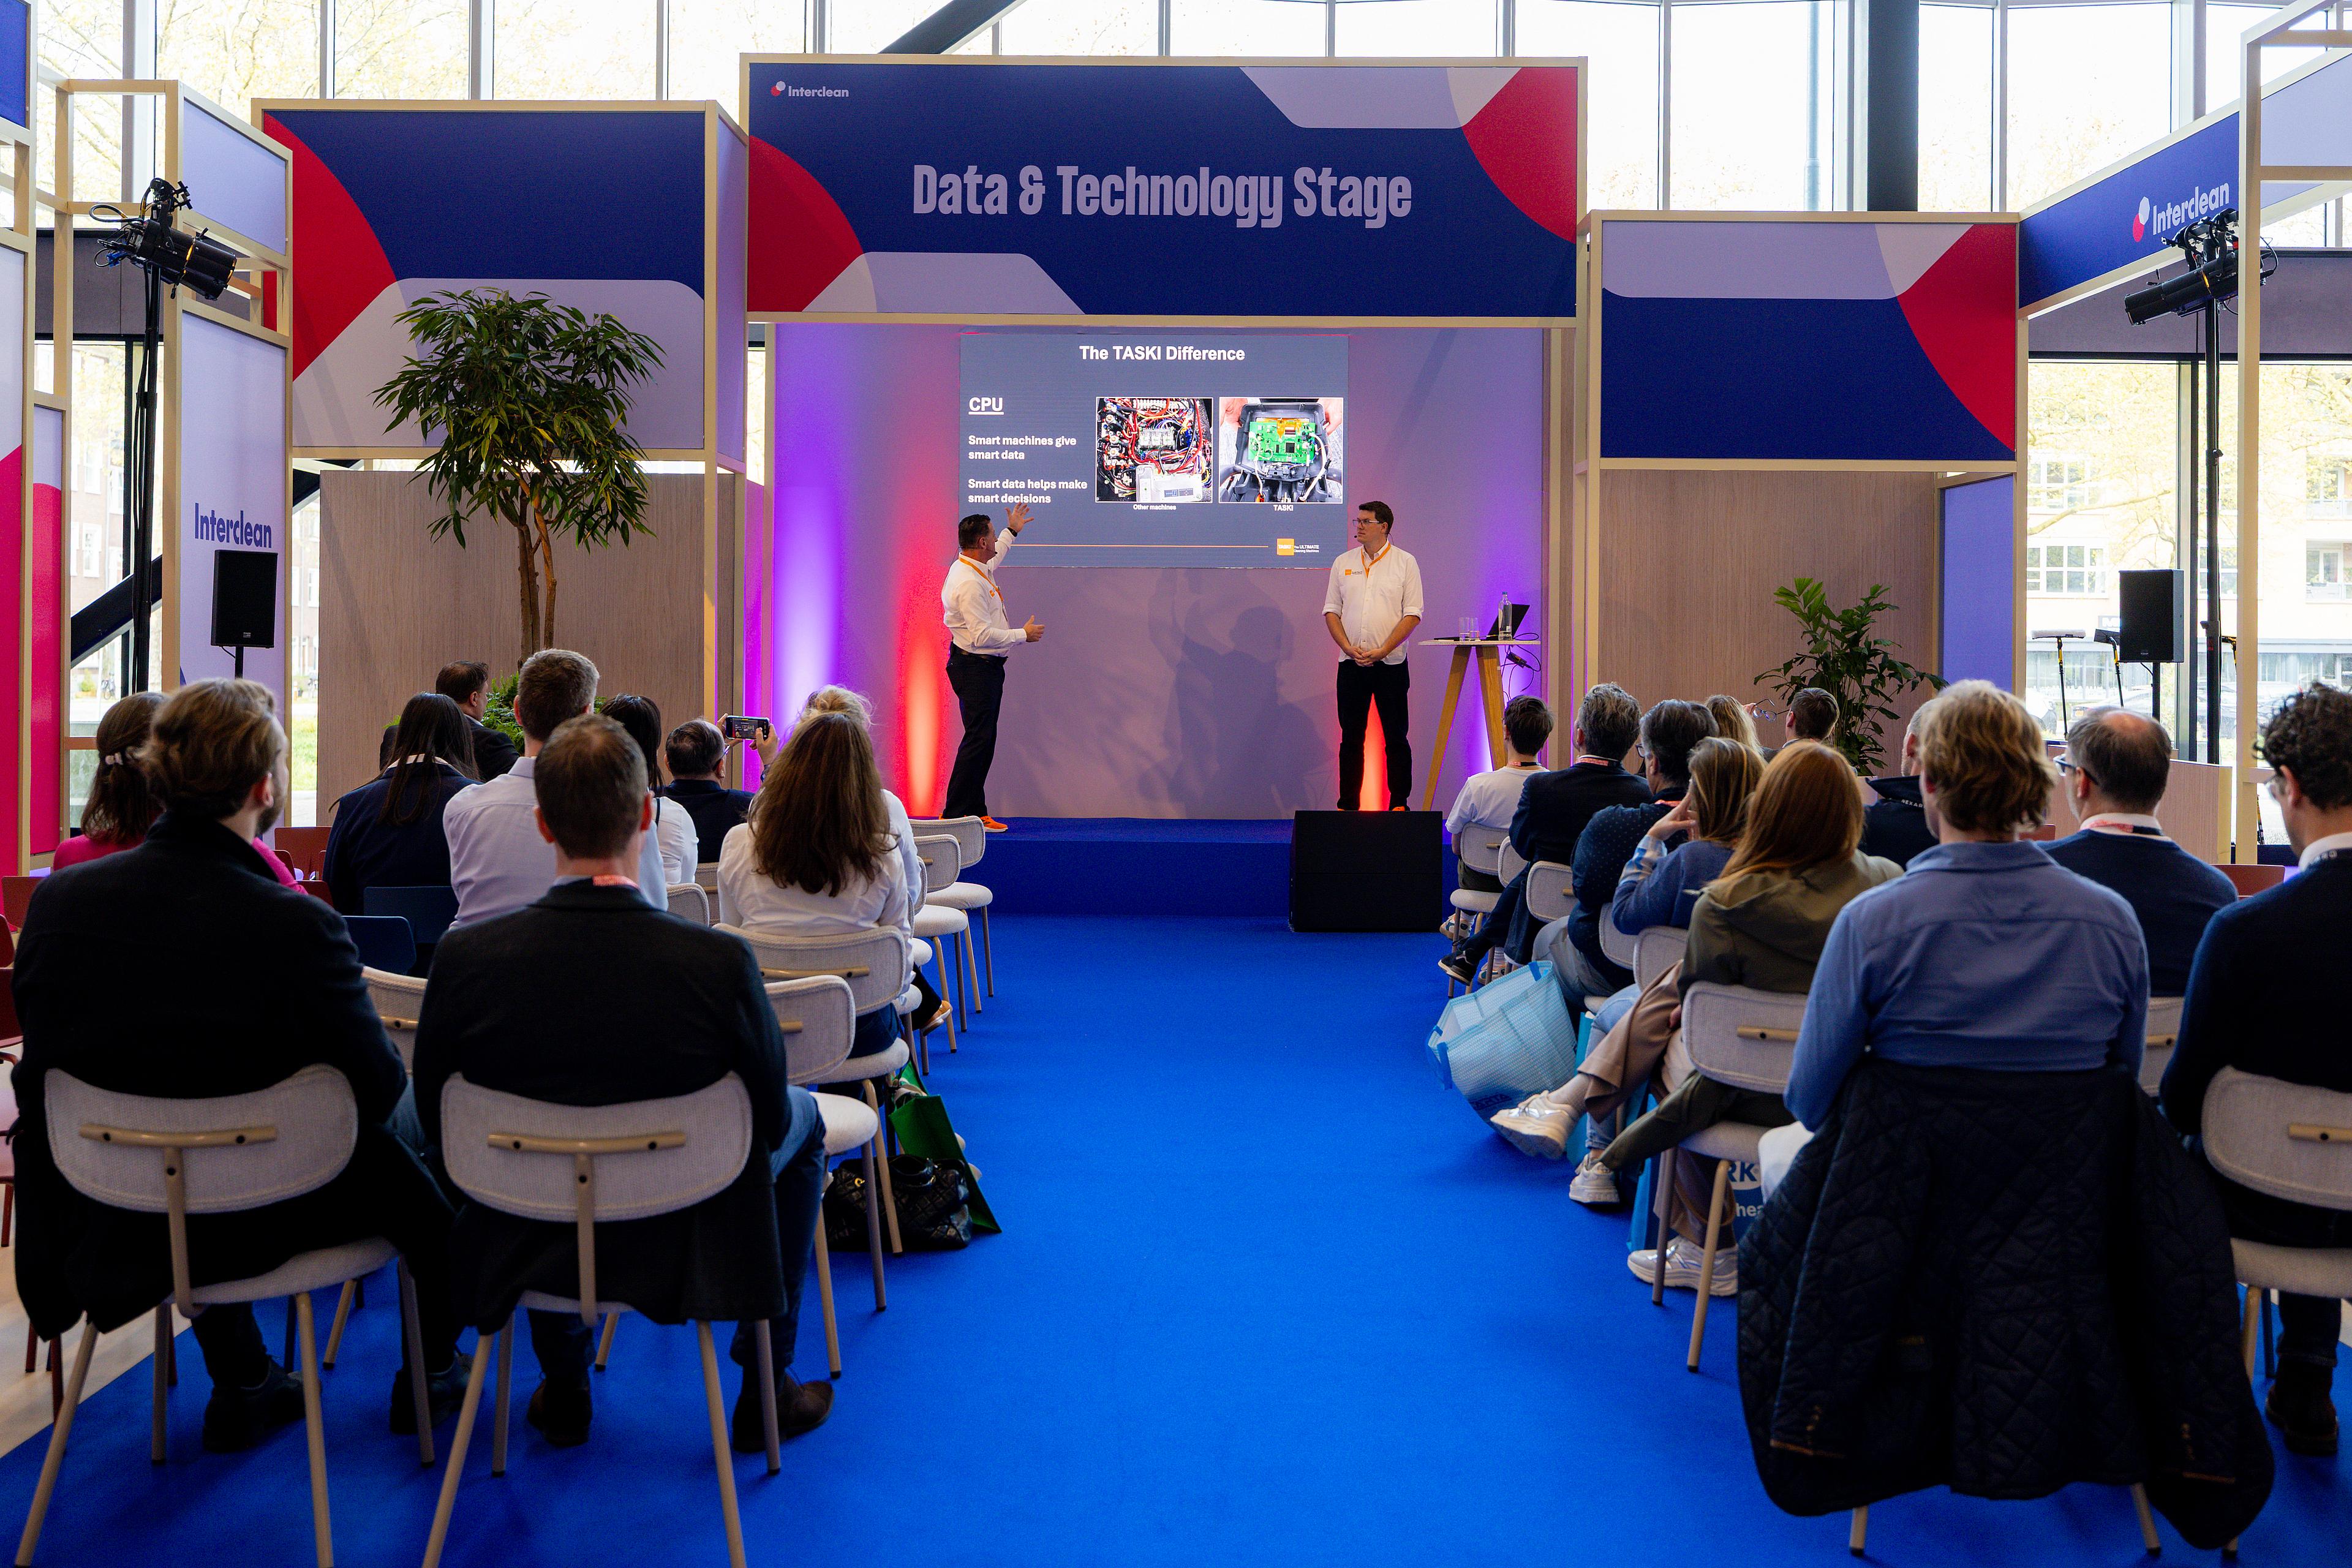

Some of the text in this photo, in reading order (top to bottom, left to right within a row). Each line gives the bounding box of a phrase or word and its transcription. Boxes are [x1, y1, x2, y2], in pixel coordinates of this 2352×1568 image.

[788, 85, 849, 97] Interclean
[913, 164, 1412, 228] Data & Technology Stage
[2153, 183, 2229, 235] Interclean
[1079, 345, 1245, 361] The TASKI Difference
[969, 397, 1003, 412] CPU
[968, 435, 1077, 448] Smart machines give
[968, 450, 1025, 460] smart data
[968, 478, 1088, 491] Smart data helps make
[968, 493, 1051, 503] smart decisions
[195, 502, 271, 548] Interclean
[1901, 799, 1923, 808] NEXAR
